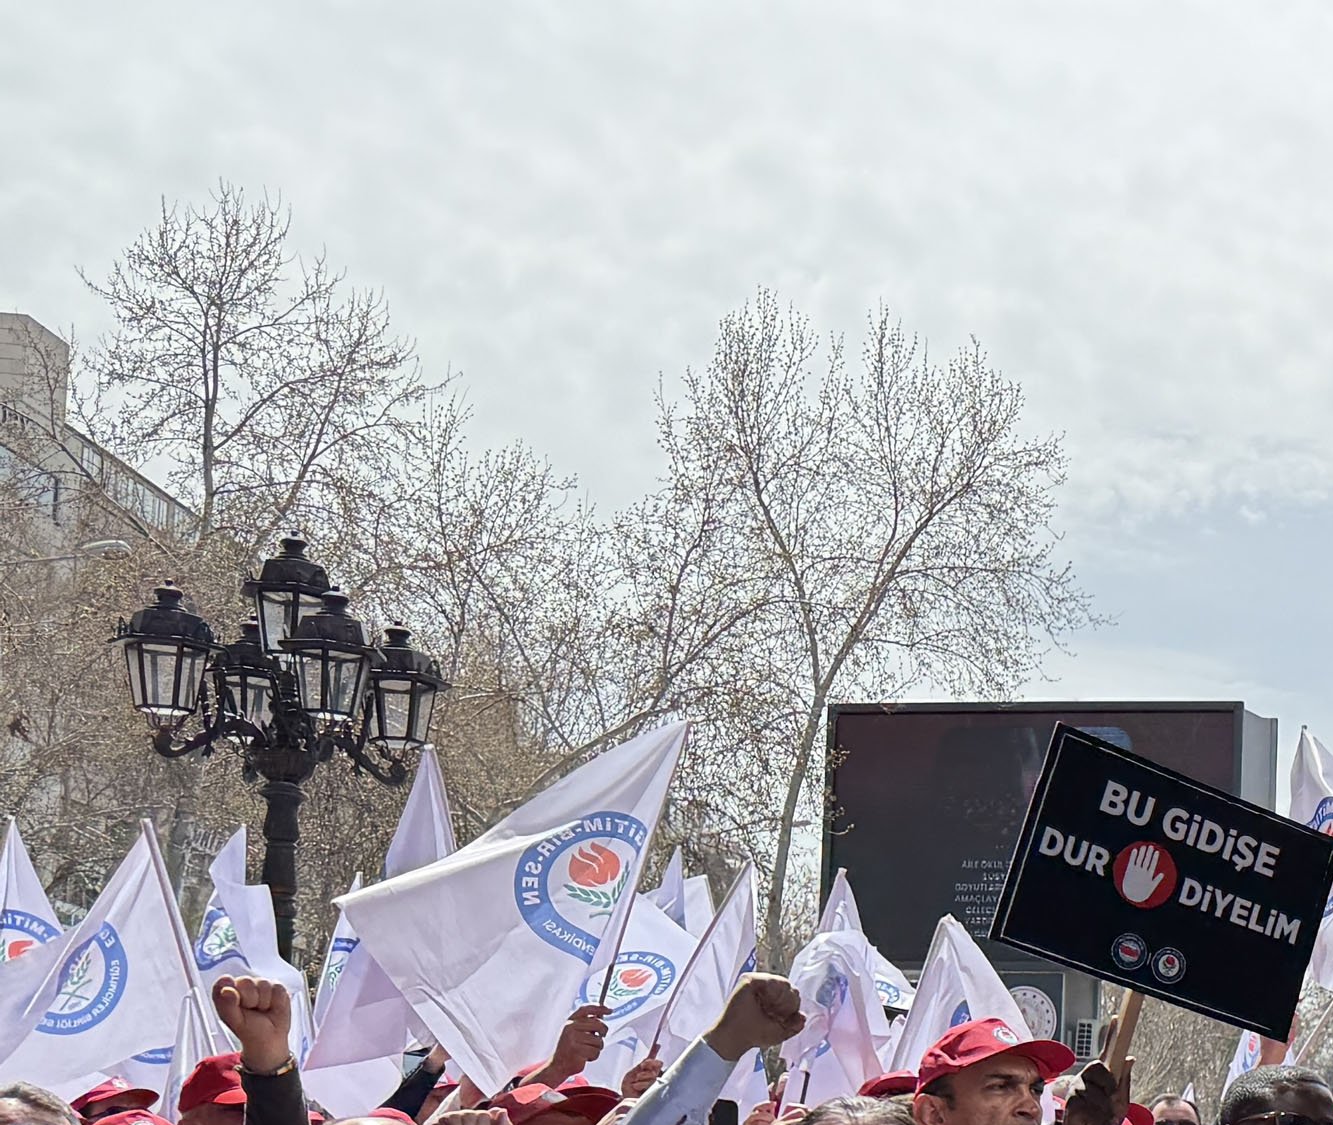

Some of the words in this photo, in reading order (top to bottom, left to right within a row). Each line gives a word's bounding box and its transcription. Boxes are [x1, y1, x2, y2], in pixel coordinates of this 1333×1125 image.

[1100, 779, 1157, 827] BU
[1162, 807, 1281, 878] GİDİŞE
[1039, 826, 1111, 877] DUR
[1178, 877, 1301, 945] DİYELİM
